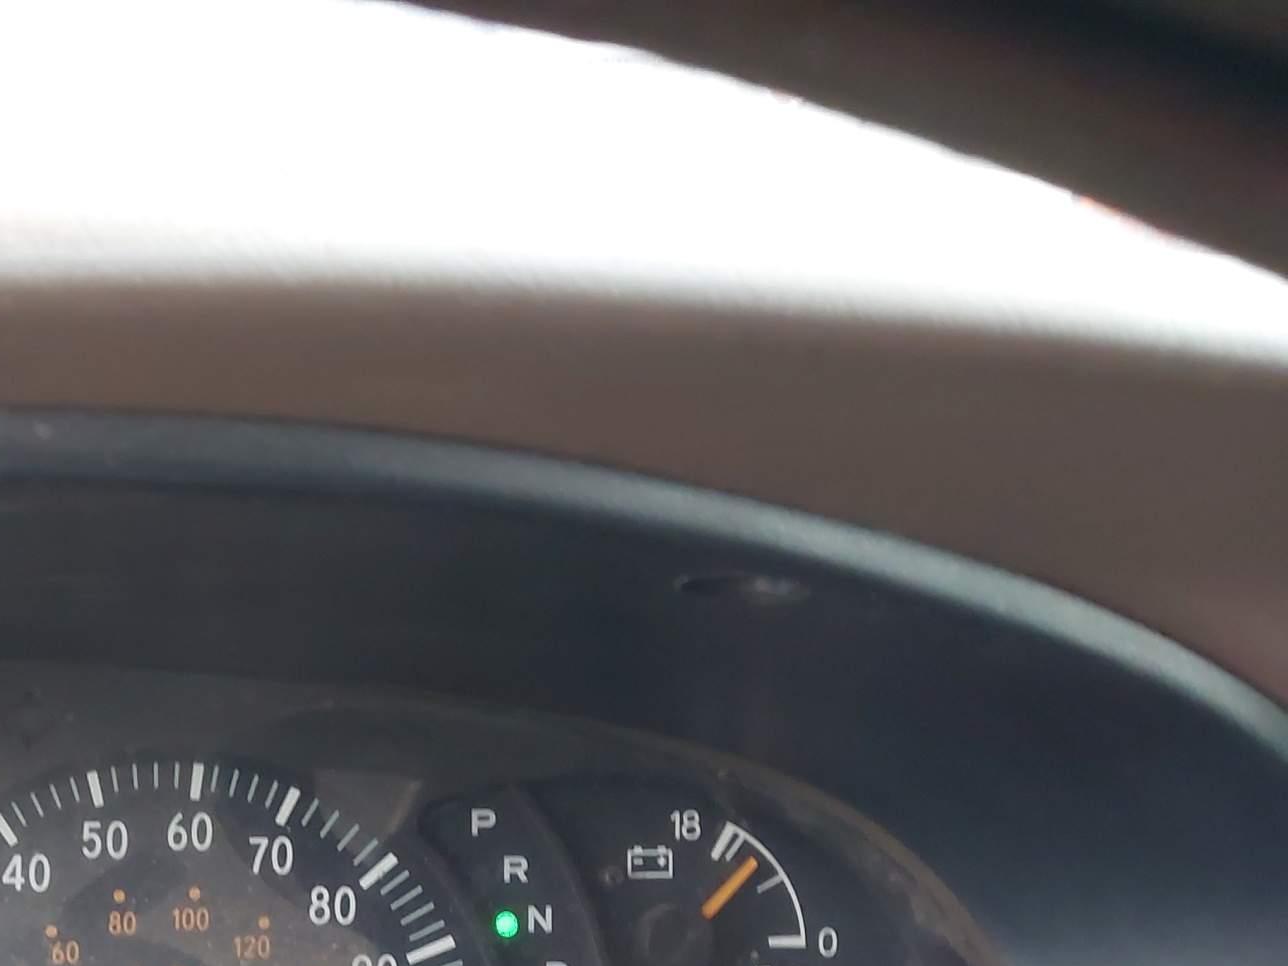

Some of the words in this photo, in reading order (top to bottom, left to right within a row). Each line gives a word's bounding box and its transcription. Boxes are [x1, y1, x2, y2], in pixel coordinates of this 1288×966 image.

[167, 812, 213, 852] 60
[471, 808, 496, 836] P
[670, 810, 701, 841] 18
[81, 821, 128, 861] 50
[249, 836, 294, 876] 70
[504, 855, 527, 884] R
[2, 853, 51, 893] 40
[172, 909, 210, 931] 100
[309, 886, 356, 926] 80
[528, 905, 553, 934] N
[108, 912, 137, 935] 80
[51, 941, 80, 965] 60
[234, 935, 271, 959] 120
